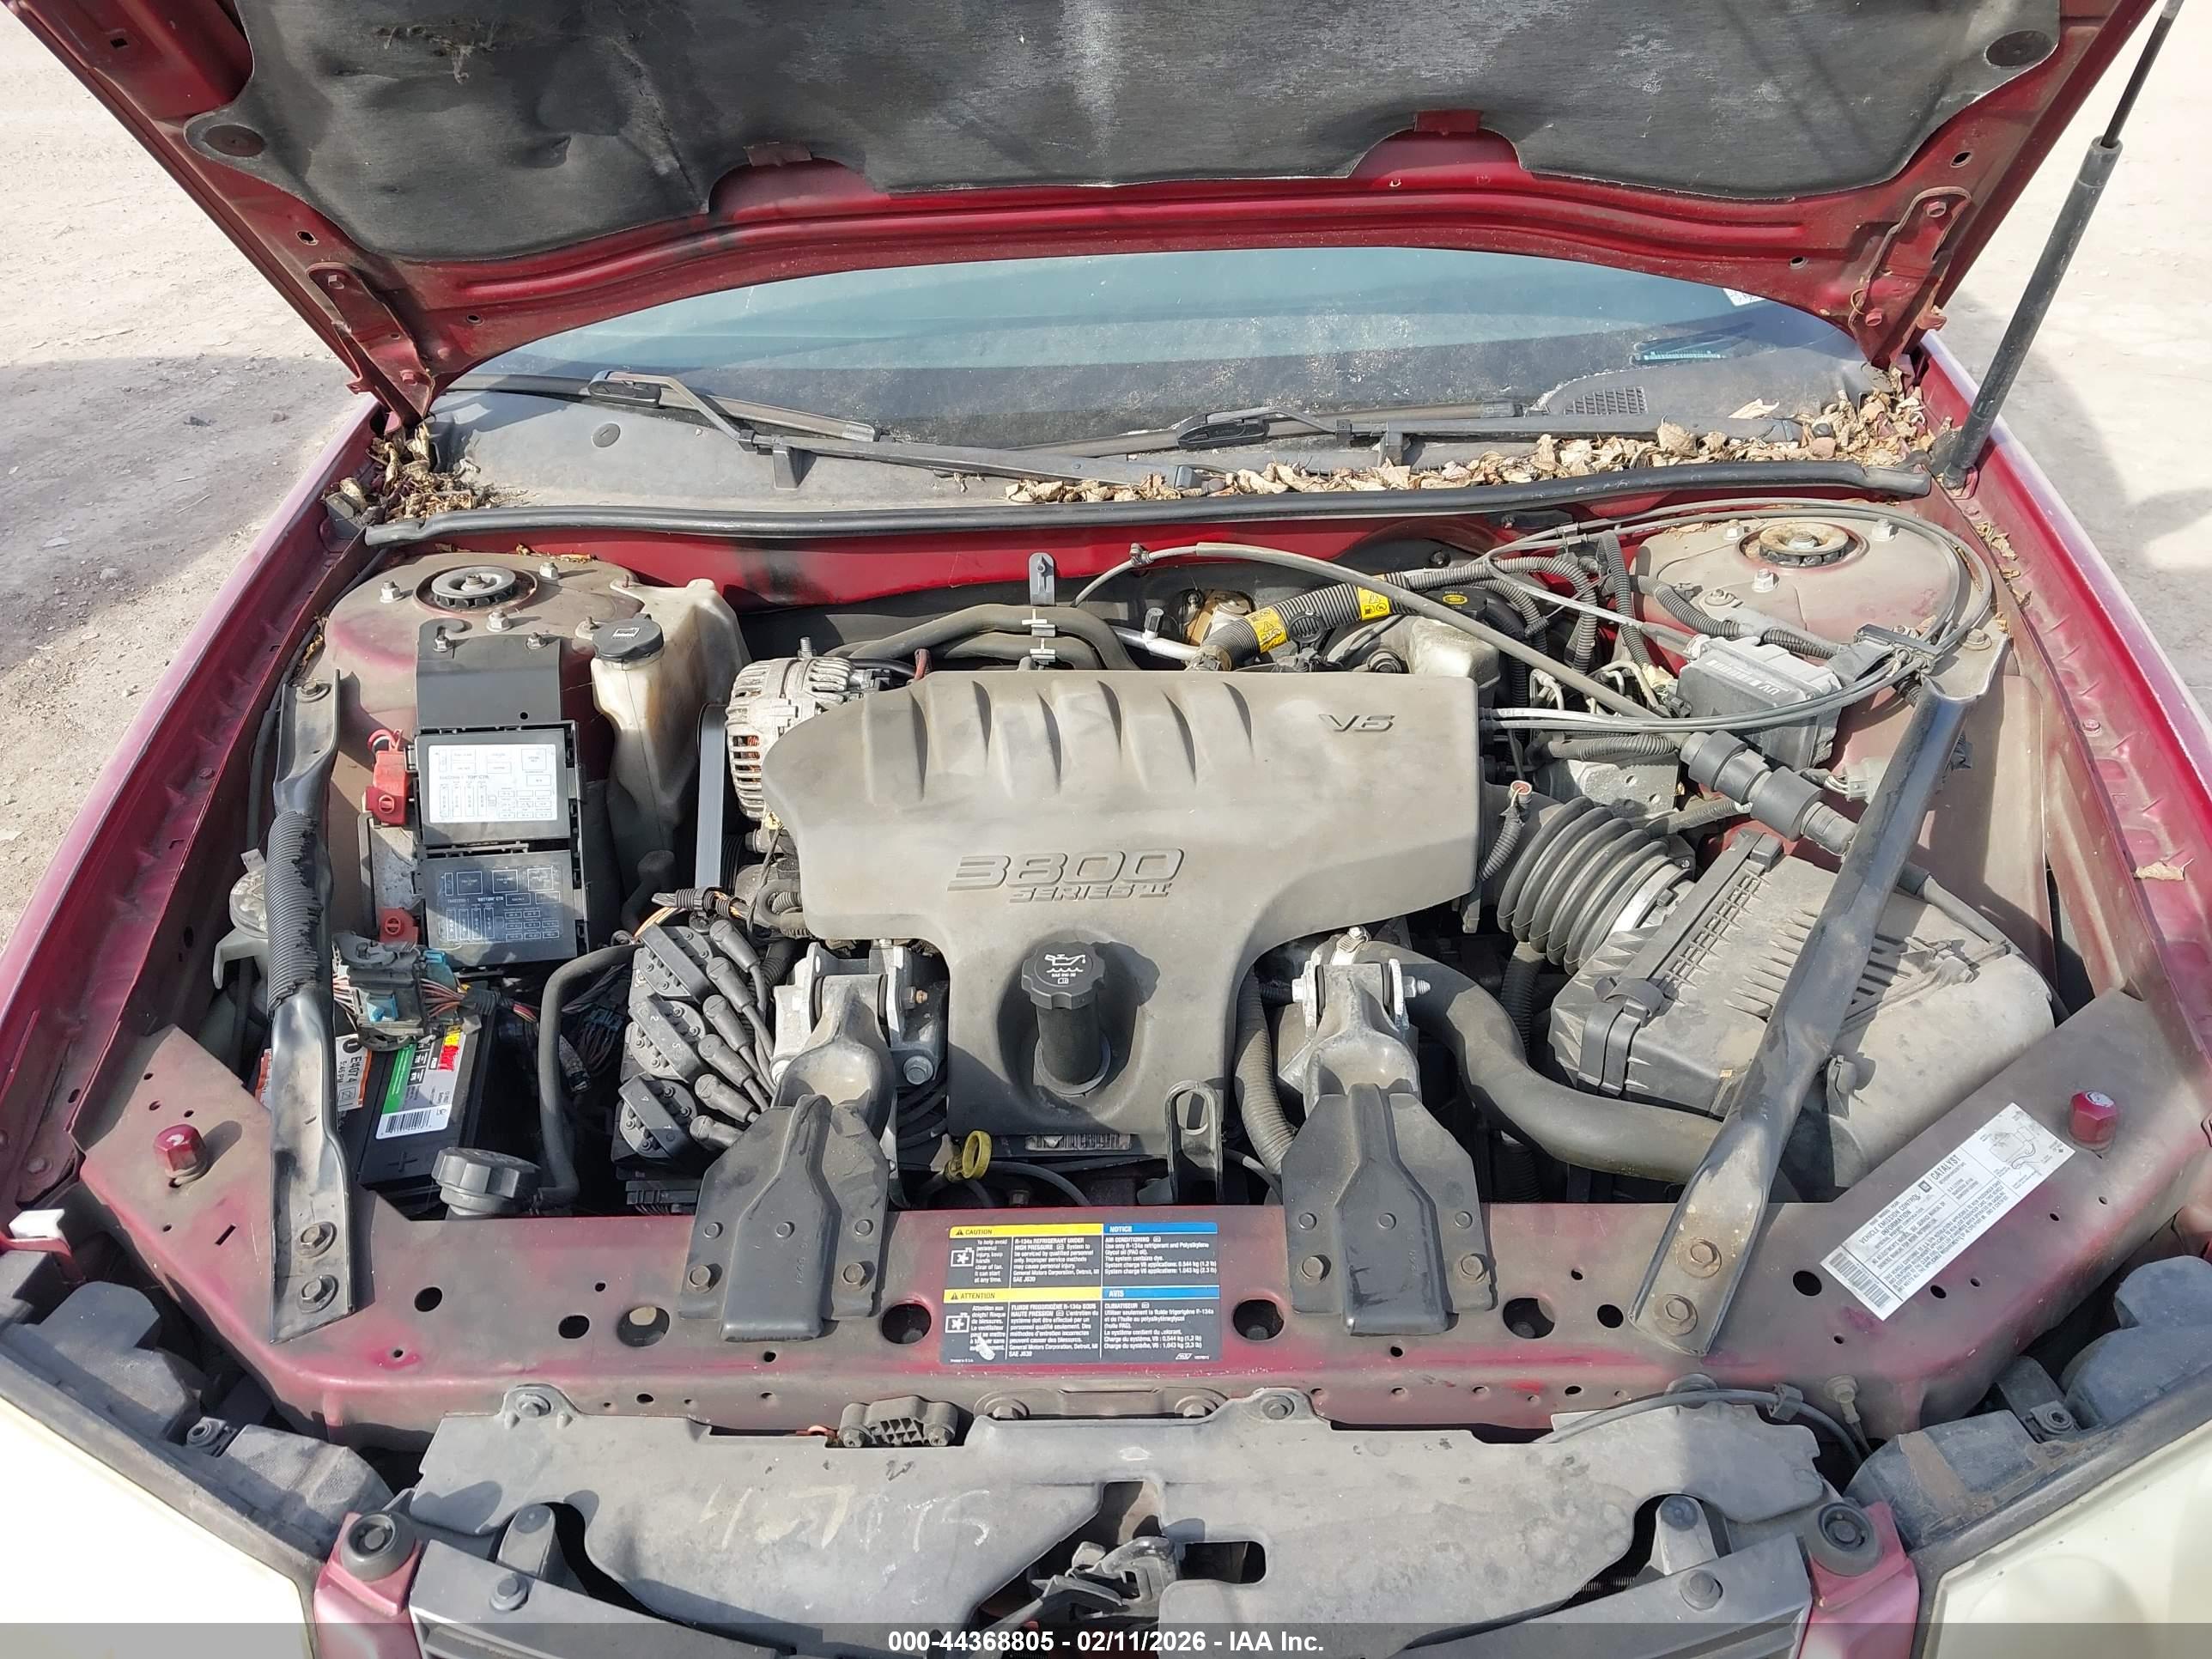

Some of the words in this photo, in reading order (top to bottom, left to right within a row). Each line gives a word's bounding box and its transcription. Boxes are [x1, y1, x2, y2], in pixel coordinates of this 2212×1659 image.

[1318, 714, 1396, 732] V6
[946, 848, 1185, 892] 3800
[1009, 884, 1135, 903] SERIES
[1929, 1153, 1962, 1181] CATALYST
[1858, 1226, 1880, 1244] VEHICLE
[1876, 1208, 1901, 1229] EMISSION
[1897, 1192, 1920, 1212] CONTROL
[1880, 1208, 1912, 1236] INFORMATION
